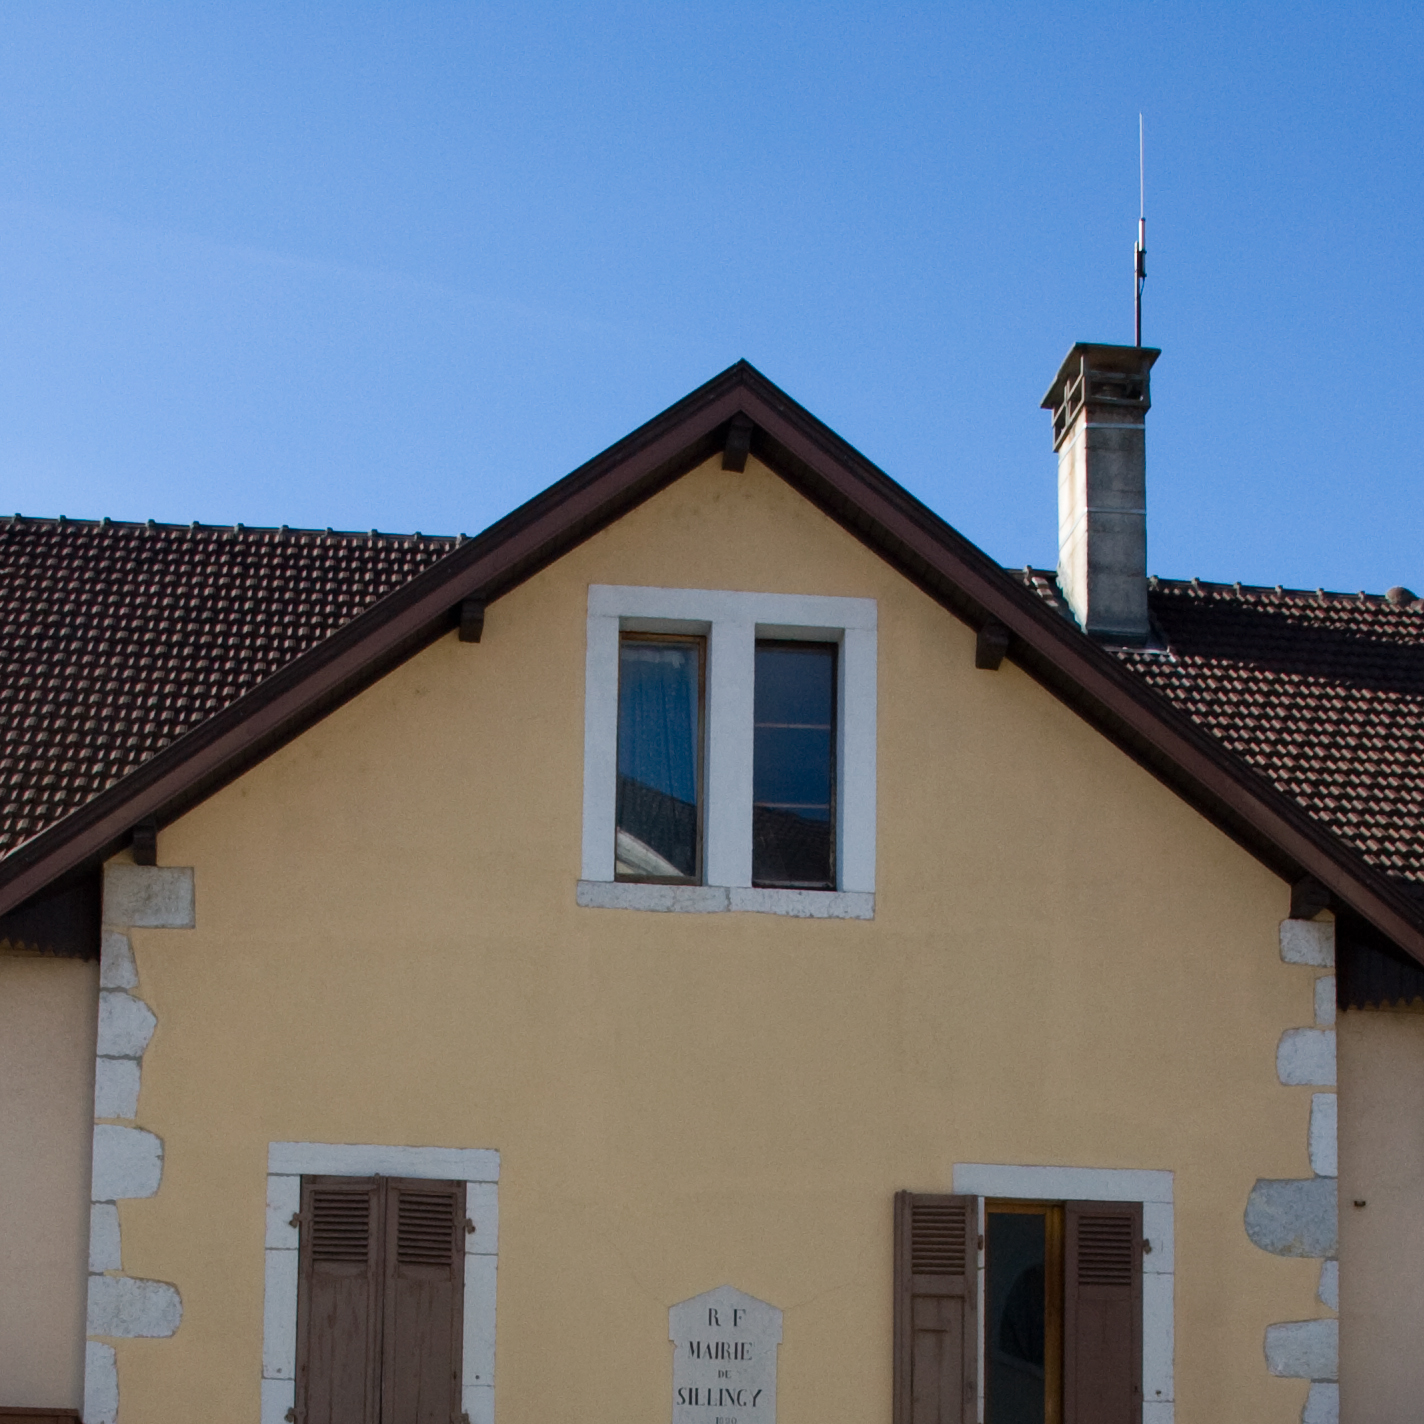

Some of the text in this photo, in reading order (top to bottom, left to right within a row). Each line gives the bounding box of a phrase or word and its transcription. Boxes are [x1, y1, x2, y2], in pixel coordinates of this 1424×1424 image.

[708, 1308, 746, 1327] R F
[688, 1340, 753, 1361] MAIRIE
[717, 1370, 732, 1379] DE
[677, 1387, 763, 1407] SILLINGY
